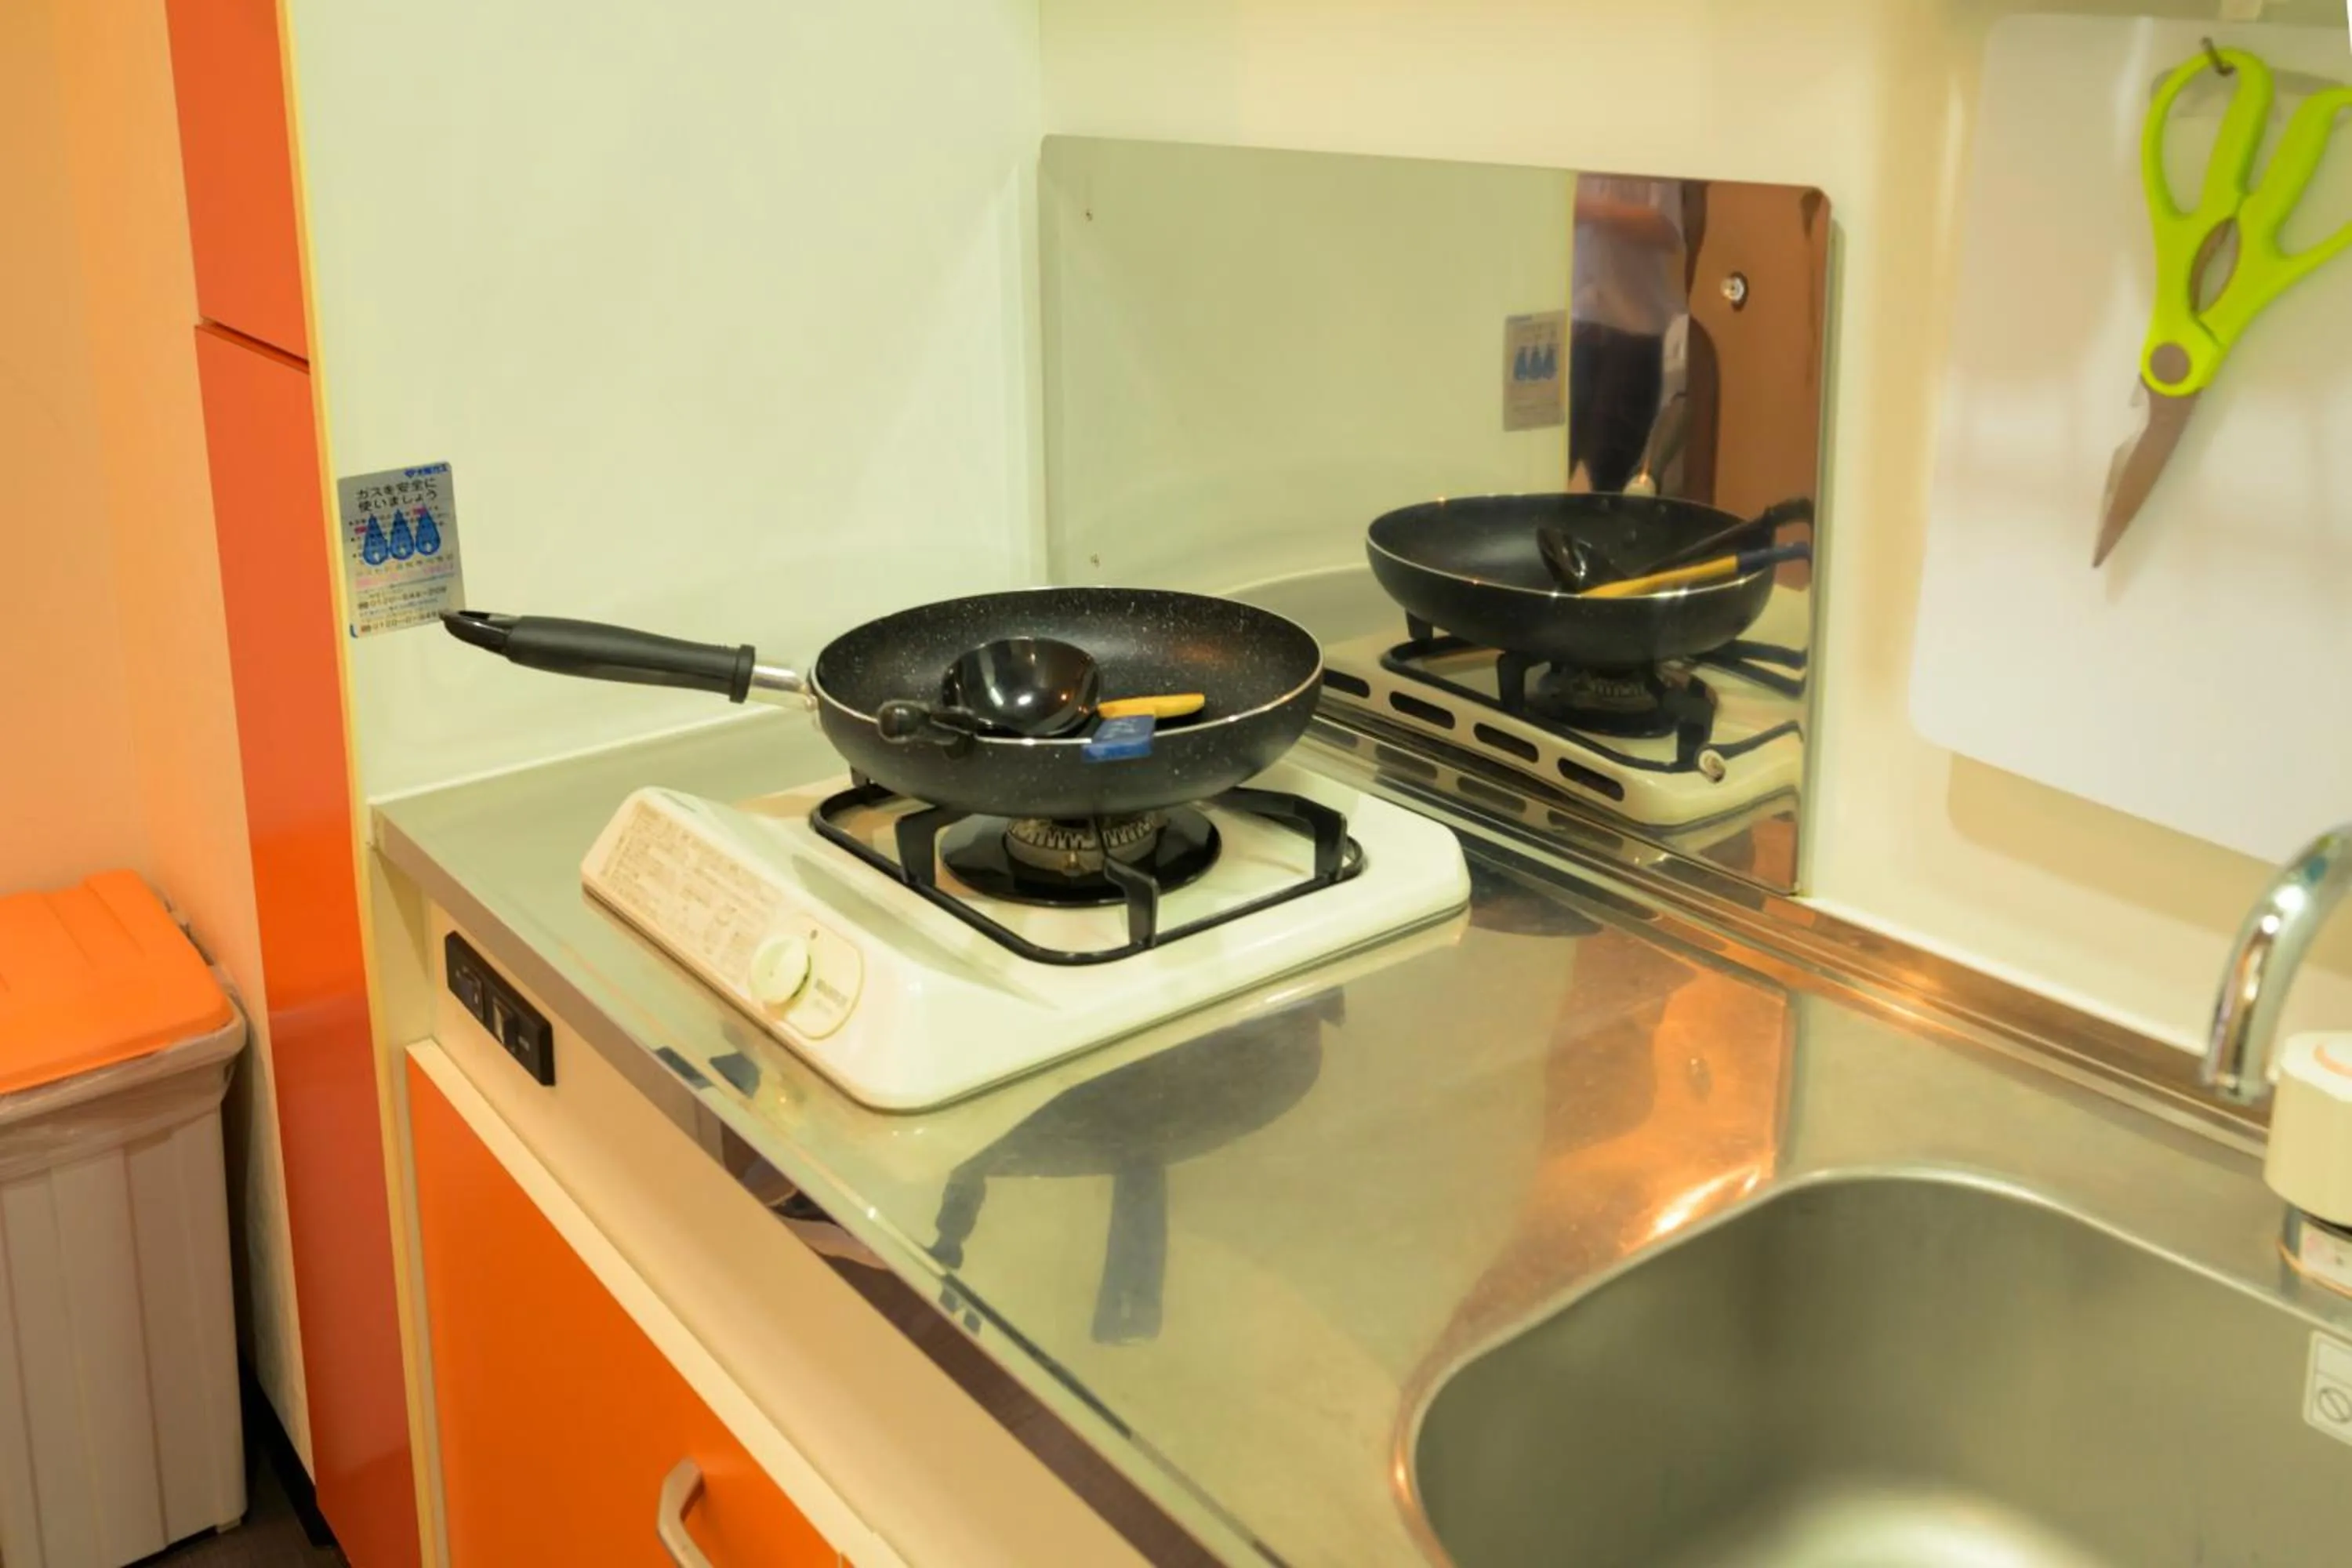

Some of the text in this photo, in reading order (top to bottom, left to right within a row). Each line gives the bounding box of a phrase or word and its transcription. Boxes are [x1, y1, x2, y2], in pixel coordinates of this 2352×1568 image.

[358, 477, 437, 500] ガスを安全に
[358, 489, 437, 512] 使いましょう
